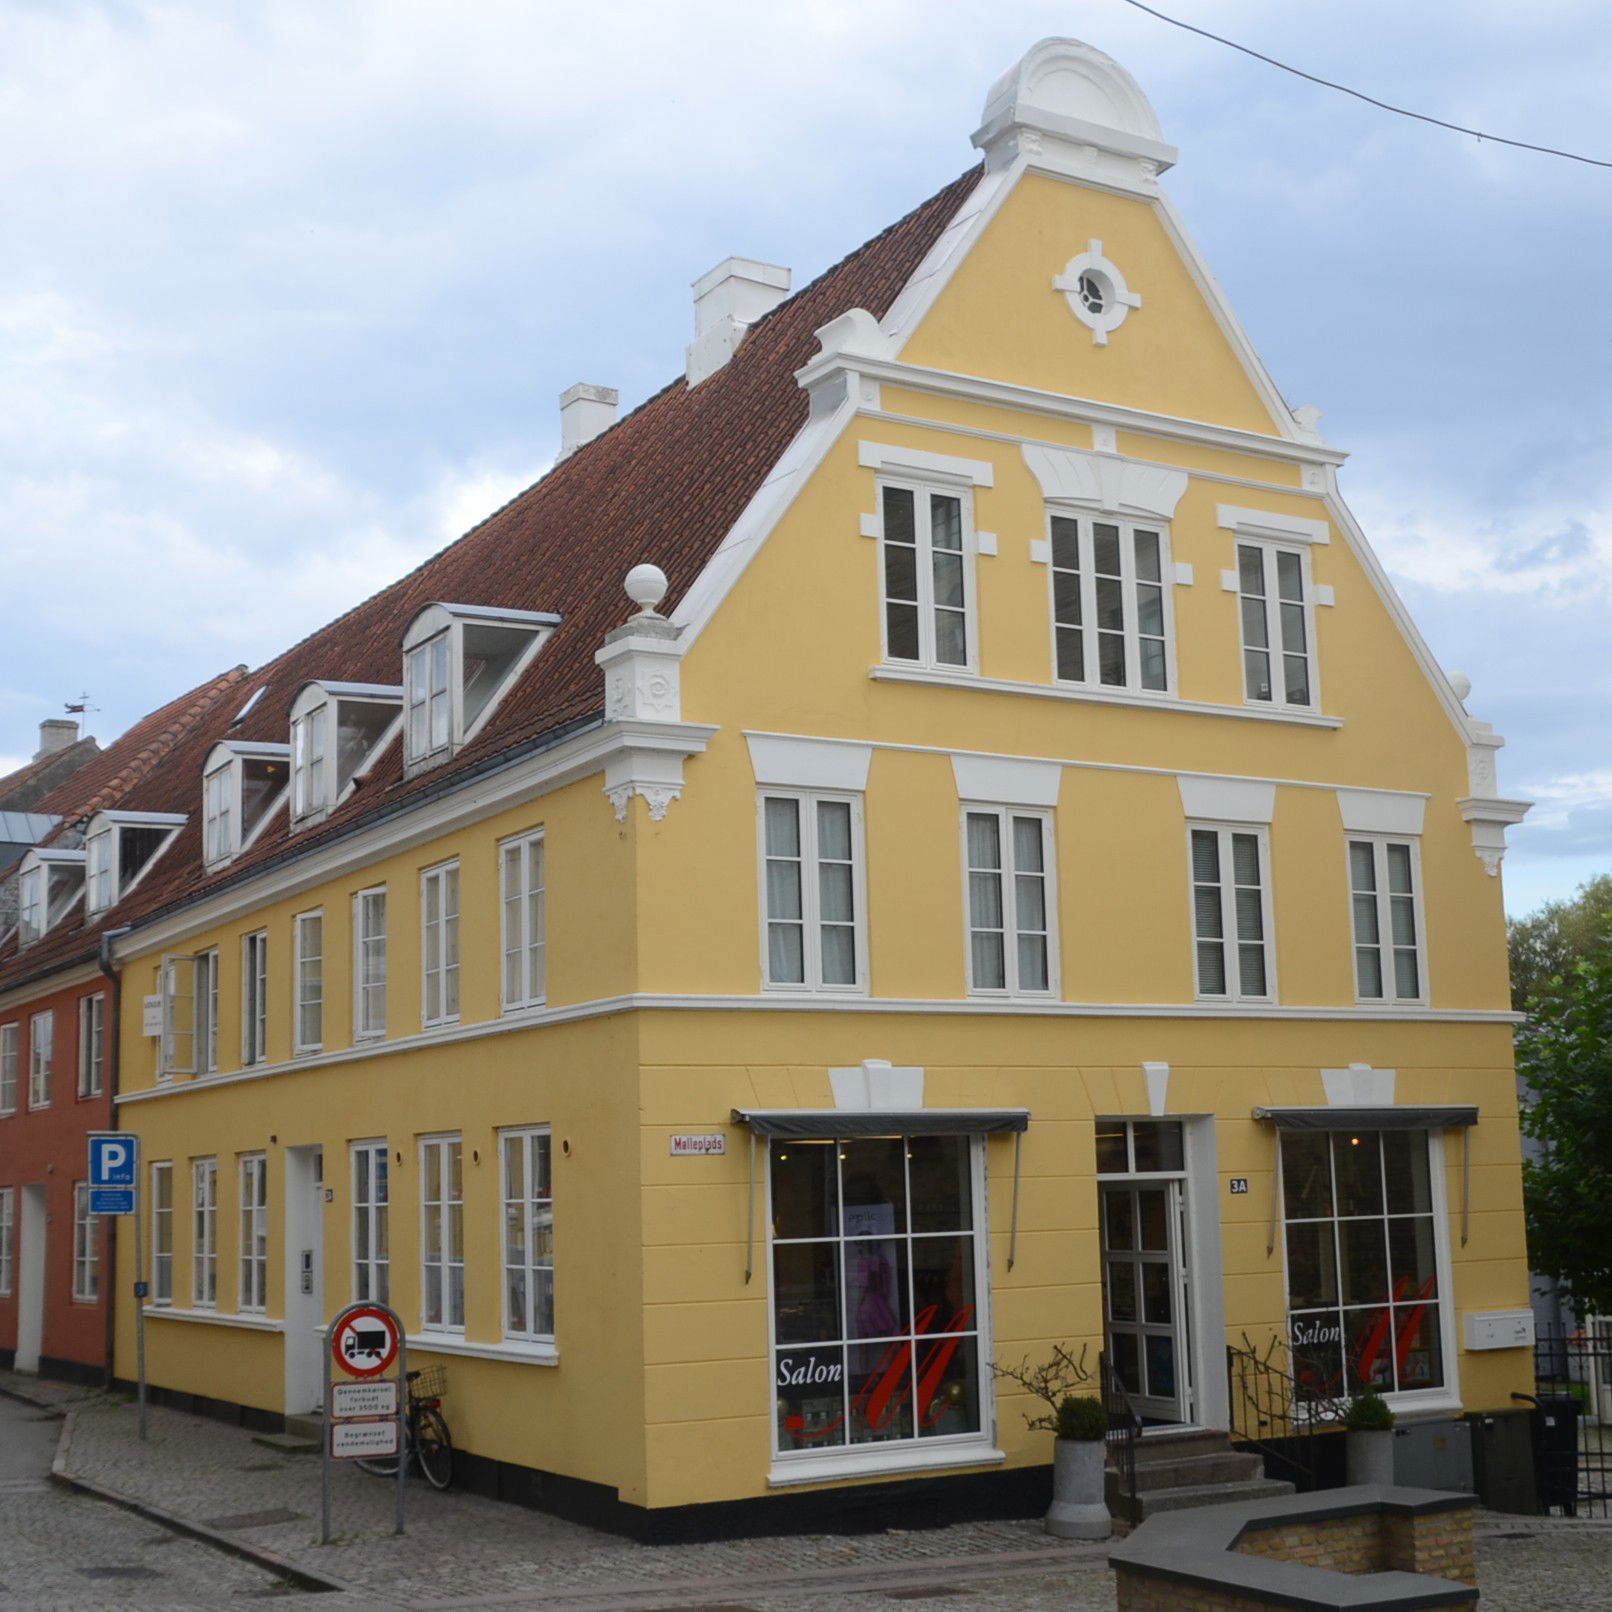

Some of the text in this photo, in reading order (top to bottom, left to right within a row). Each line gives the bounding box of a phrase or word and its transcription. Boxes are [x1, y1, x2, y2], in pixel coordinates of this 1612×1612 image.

[101, 1144, 126, 1180] P
[1231, 1180, 1247, 1193] 3A
[1293, 1320, 1340, 1346] Salon
[777, 1357, 842, 1386] Salon
